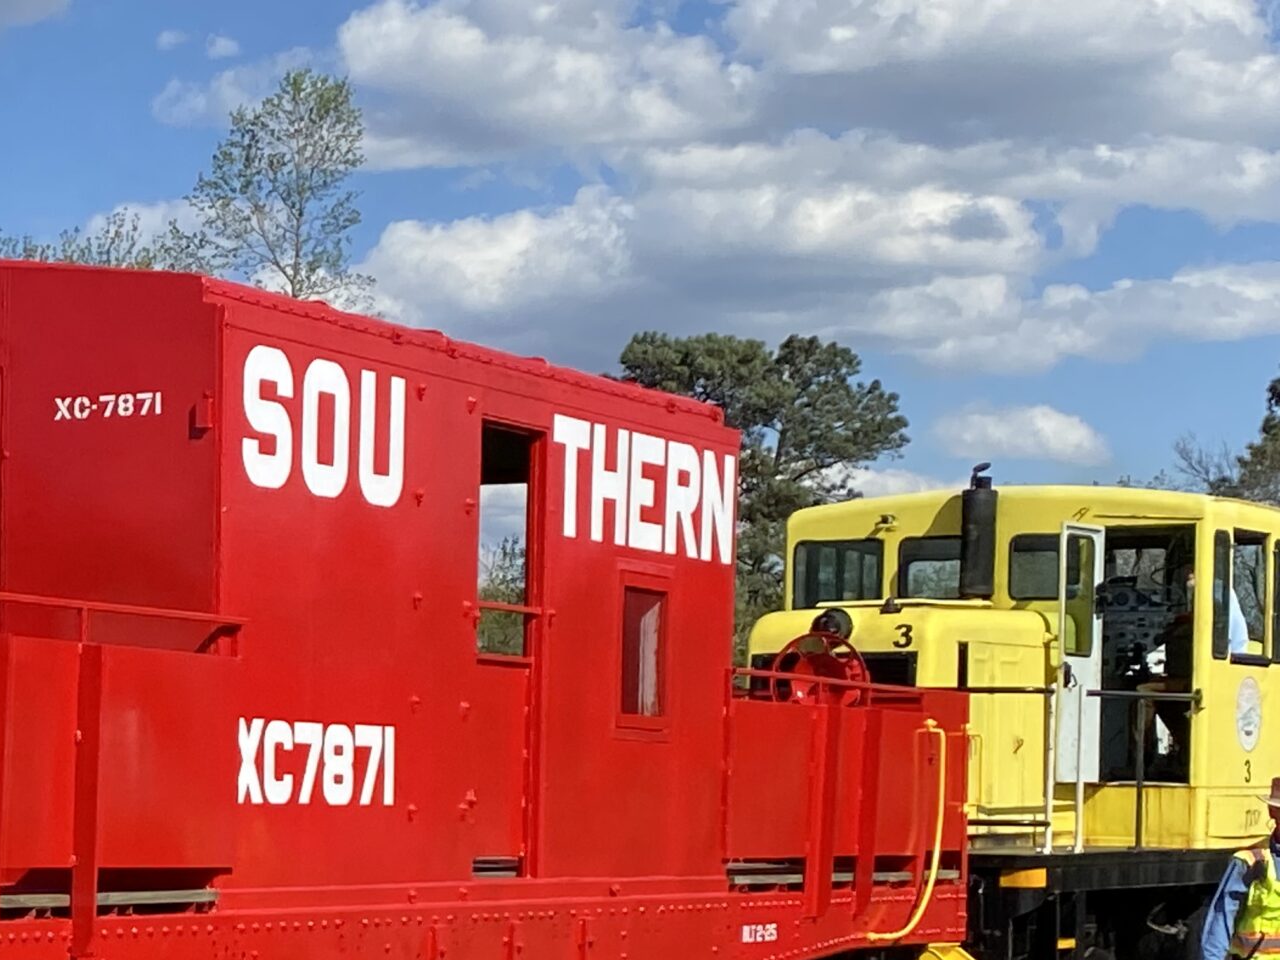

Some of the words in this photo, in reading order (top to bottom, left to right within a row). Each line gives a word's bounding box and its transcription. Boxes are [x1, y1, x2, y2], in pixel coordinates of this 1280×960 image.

[54, 391, 162, 421] XC-7871
[242, 344, 407, 507] SOU
[552, 413, 736, 566] THERN
[892, 623, 913, 649] 3
[237, 717, 396, 807] XC7871
[1244, 759, 1252, 784] 3
